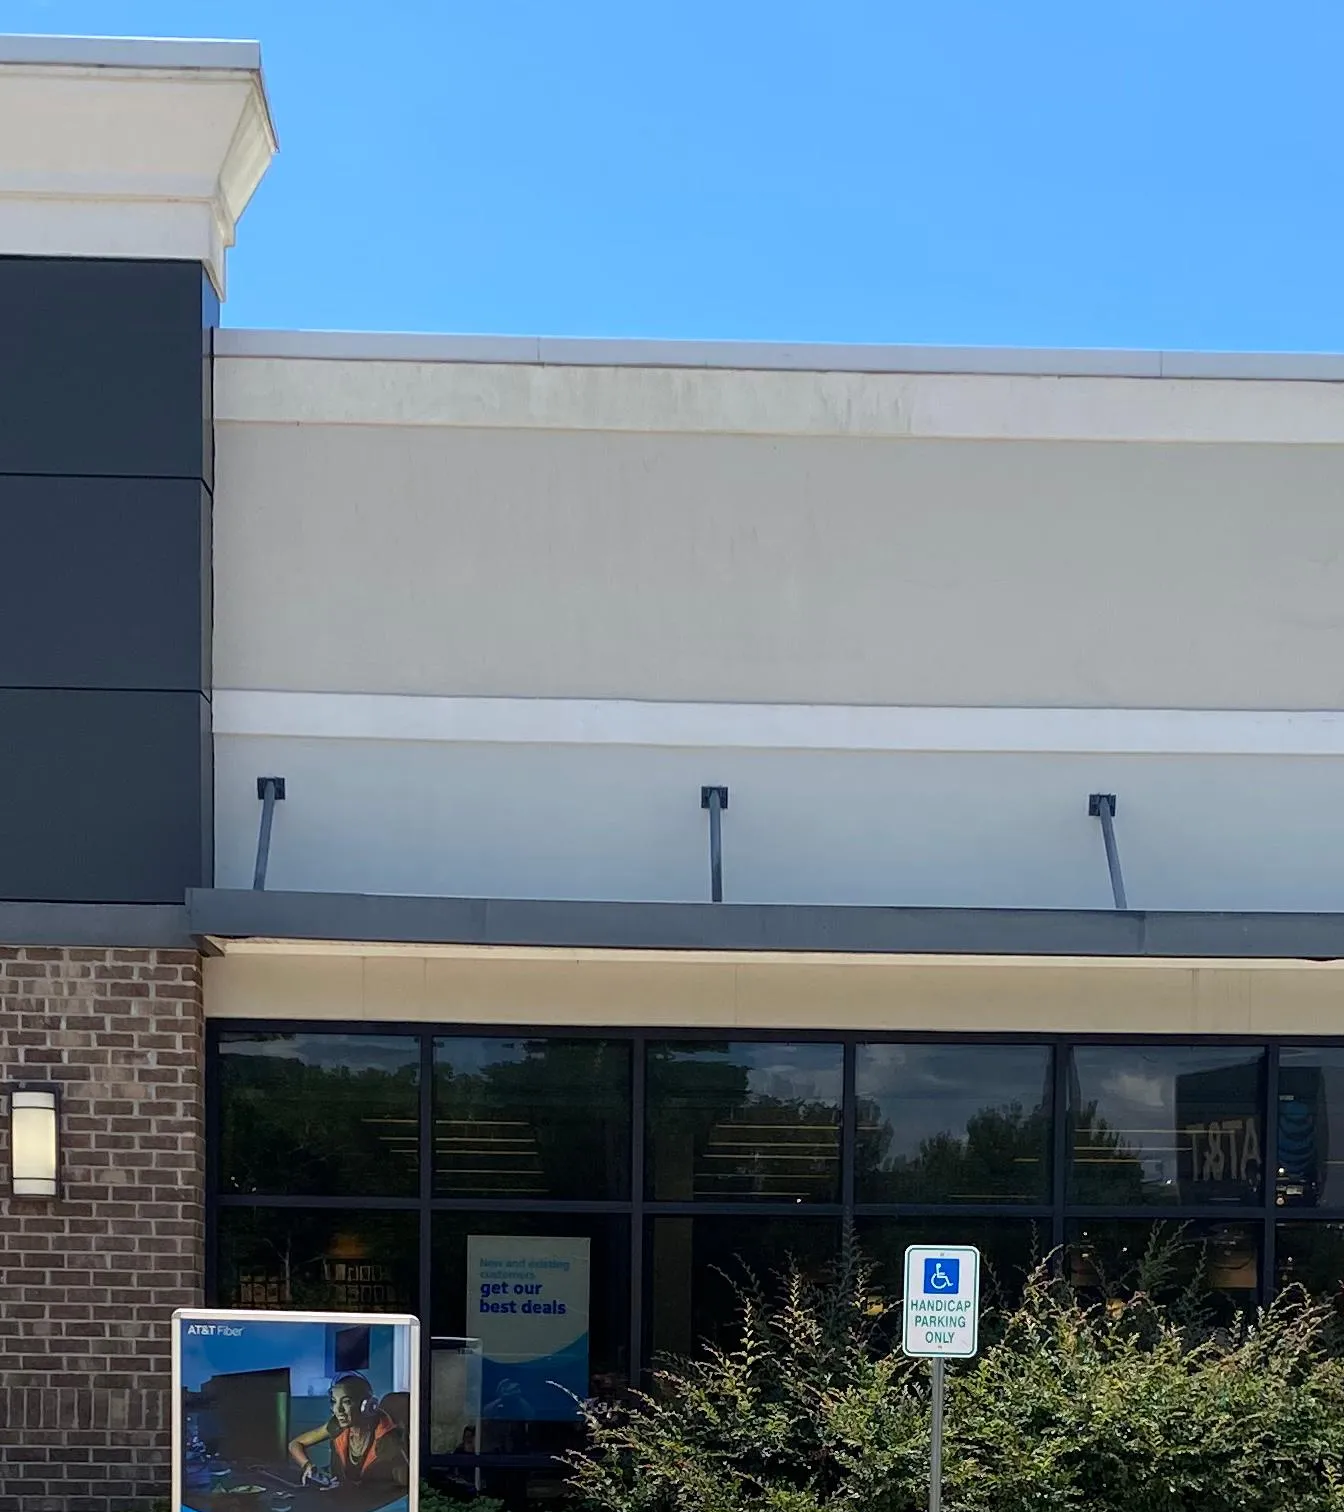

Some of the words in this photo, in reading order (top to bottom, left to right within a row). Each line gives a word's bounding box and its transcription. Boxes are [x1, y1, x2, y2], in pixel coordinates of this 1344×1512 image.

[480, 1281, 509, 1298] get
[513, 1283, 543, 1295] our
[479, 1299, 517, 1313] best
[521, 1300, 567, 1315] deals
[910, 1299, 972, 1313] HANDICAP
[915, 1315, 966, 1328] PARKING
[187, 1324, 216, 1335] AT&T
[217, 1325, 244, 1337] Fiber
[925, 1331, 956, 1344] ONLY
